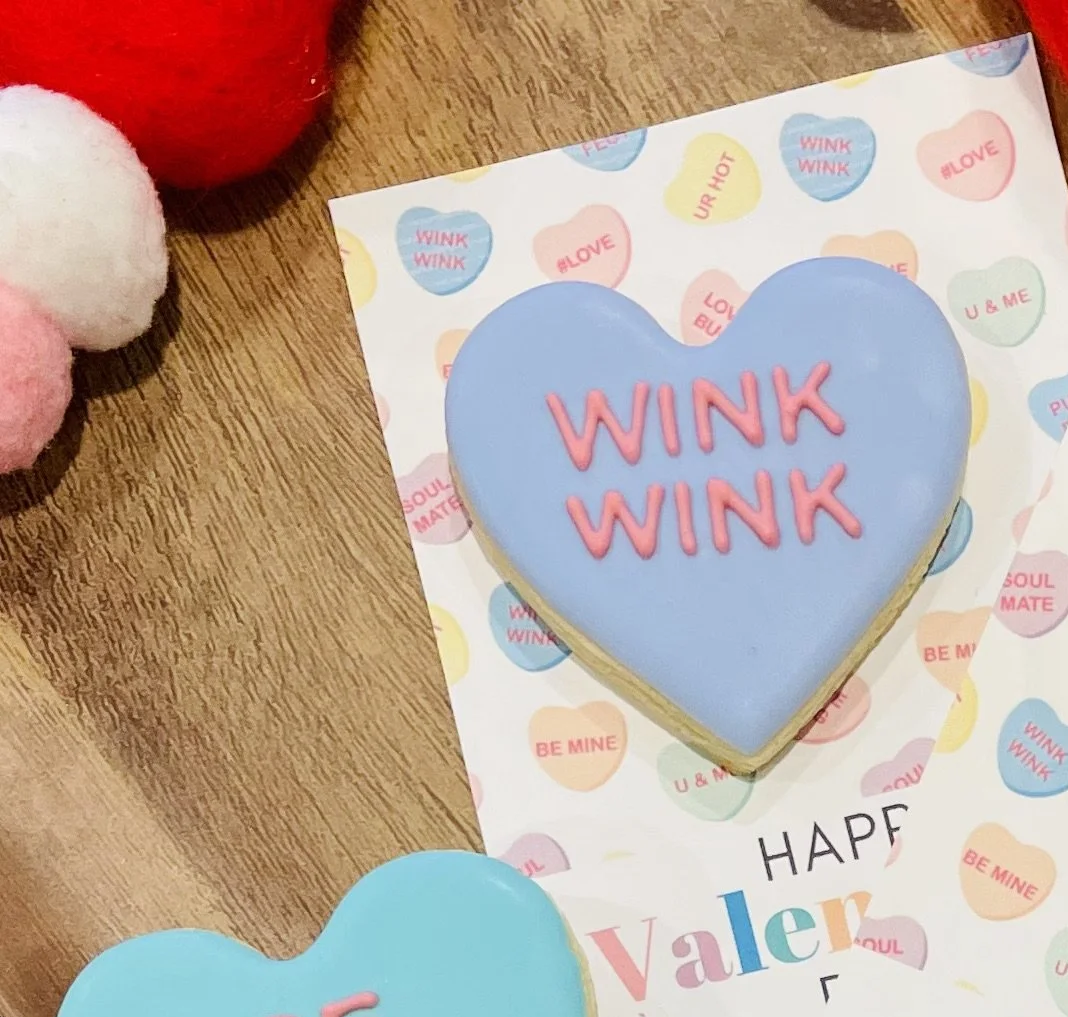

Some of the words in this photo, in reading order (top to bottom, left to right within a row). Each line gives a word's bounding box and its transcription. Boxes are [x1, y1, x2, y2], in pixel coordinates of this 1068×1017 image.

[799, 135, 853, 155] WINK
[939, 139, 1000, 180] #LOVE
[796, 157, 851, 178] WINK
[693, 192, 717, 221] UR
[711, 151, 736, 192] HOT
[415, 229, 469, 249] WINK
[557, 234, 615, 274] #LOVE
[413, 253, 467, 271] WINK
[964, 306, 979, 320] U
[985, 300, 998, 316] &
[1002, 288, 1032, 310] ME
[694, 313, 722, 336] BU
[545, 359, 846, 472] WINK
[402, 478, 452, 514] SOUL
[565, 461, 863, 561] WINK
[412, 495, 463, 533] MATE
[1003, 573, 1055, 588] SOUL
[1001, 596, 1053, 612] MATE
[924, 647, 951, 662] BE
[536, 741, 563, 757] BE
[567, 735, 618, 753] MINE
[1023, 720, 1068, 765] WINK
[1007, 738, 1052, 782] WINK
[674, 778, 688, 793] U
[695, 772, 708, 788] &
[712, 766, 728, 782] M
[758, 803, 909, 882] HAPP
[961, 848, 989, 874] BE
[989, 864, 1040, 901] MINE
